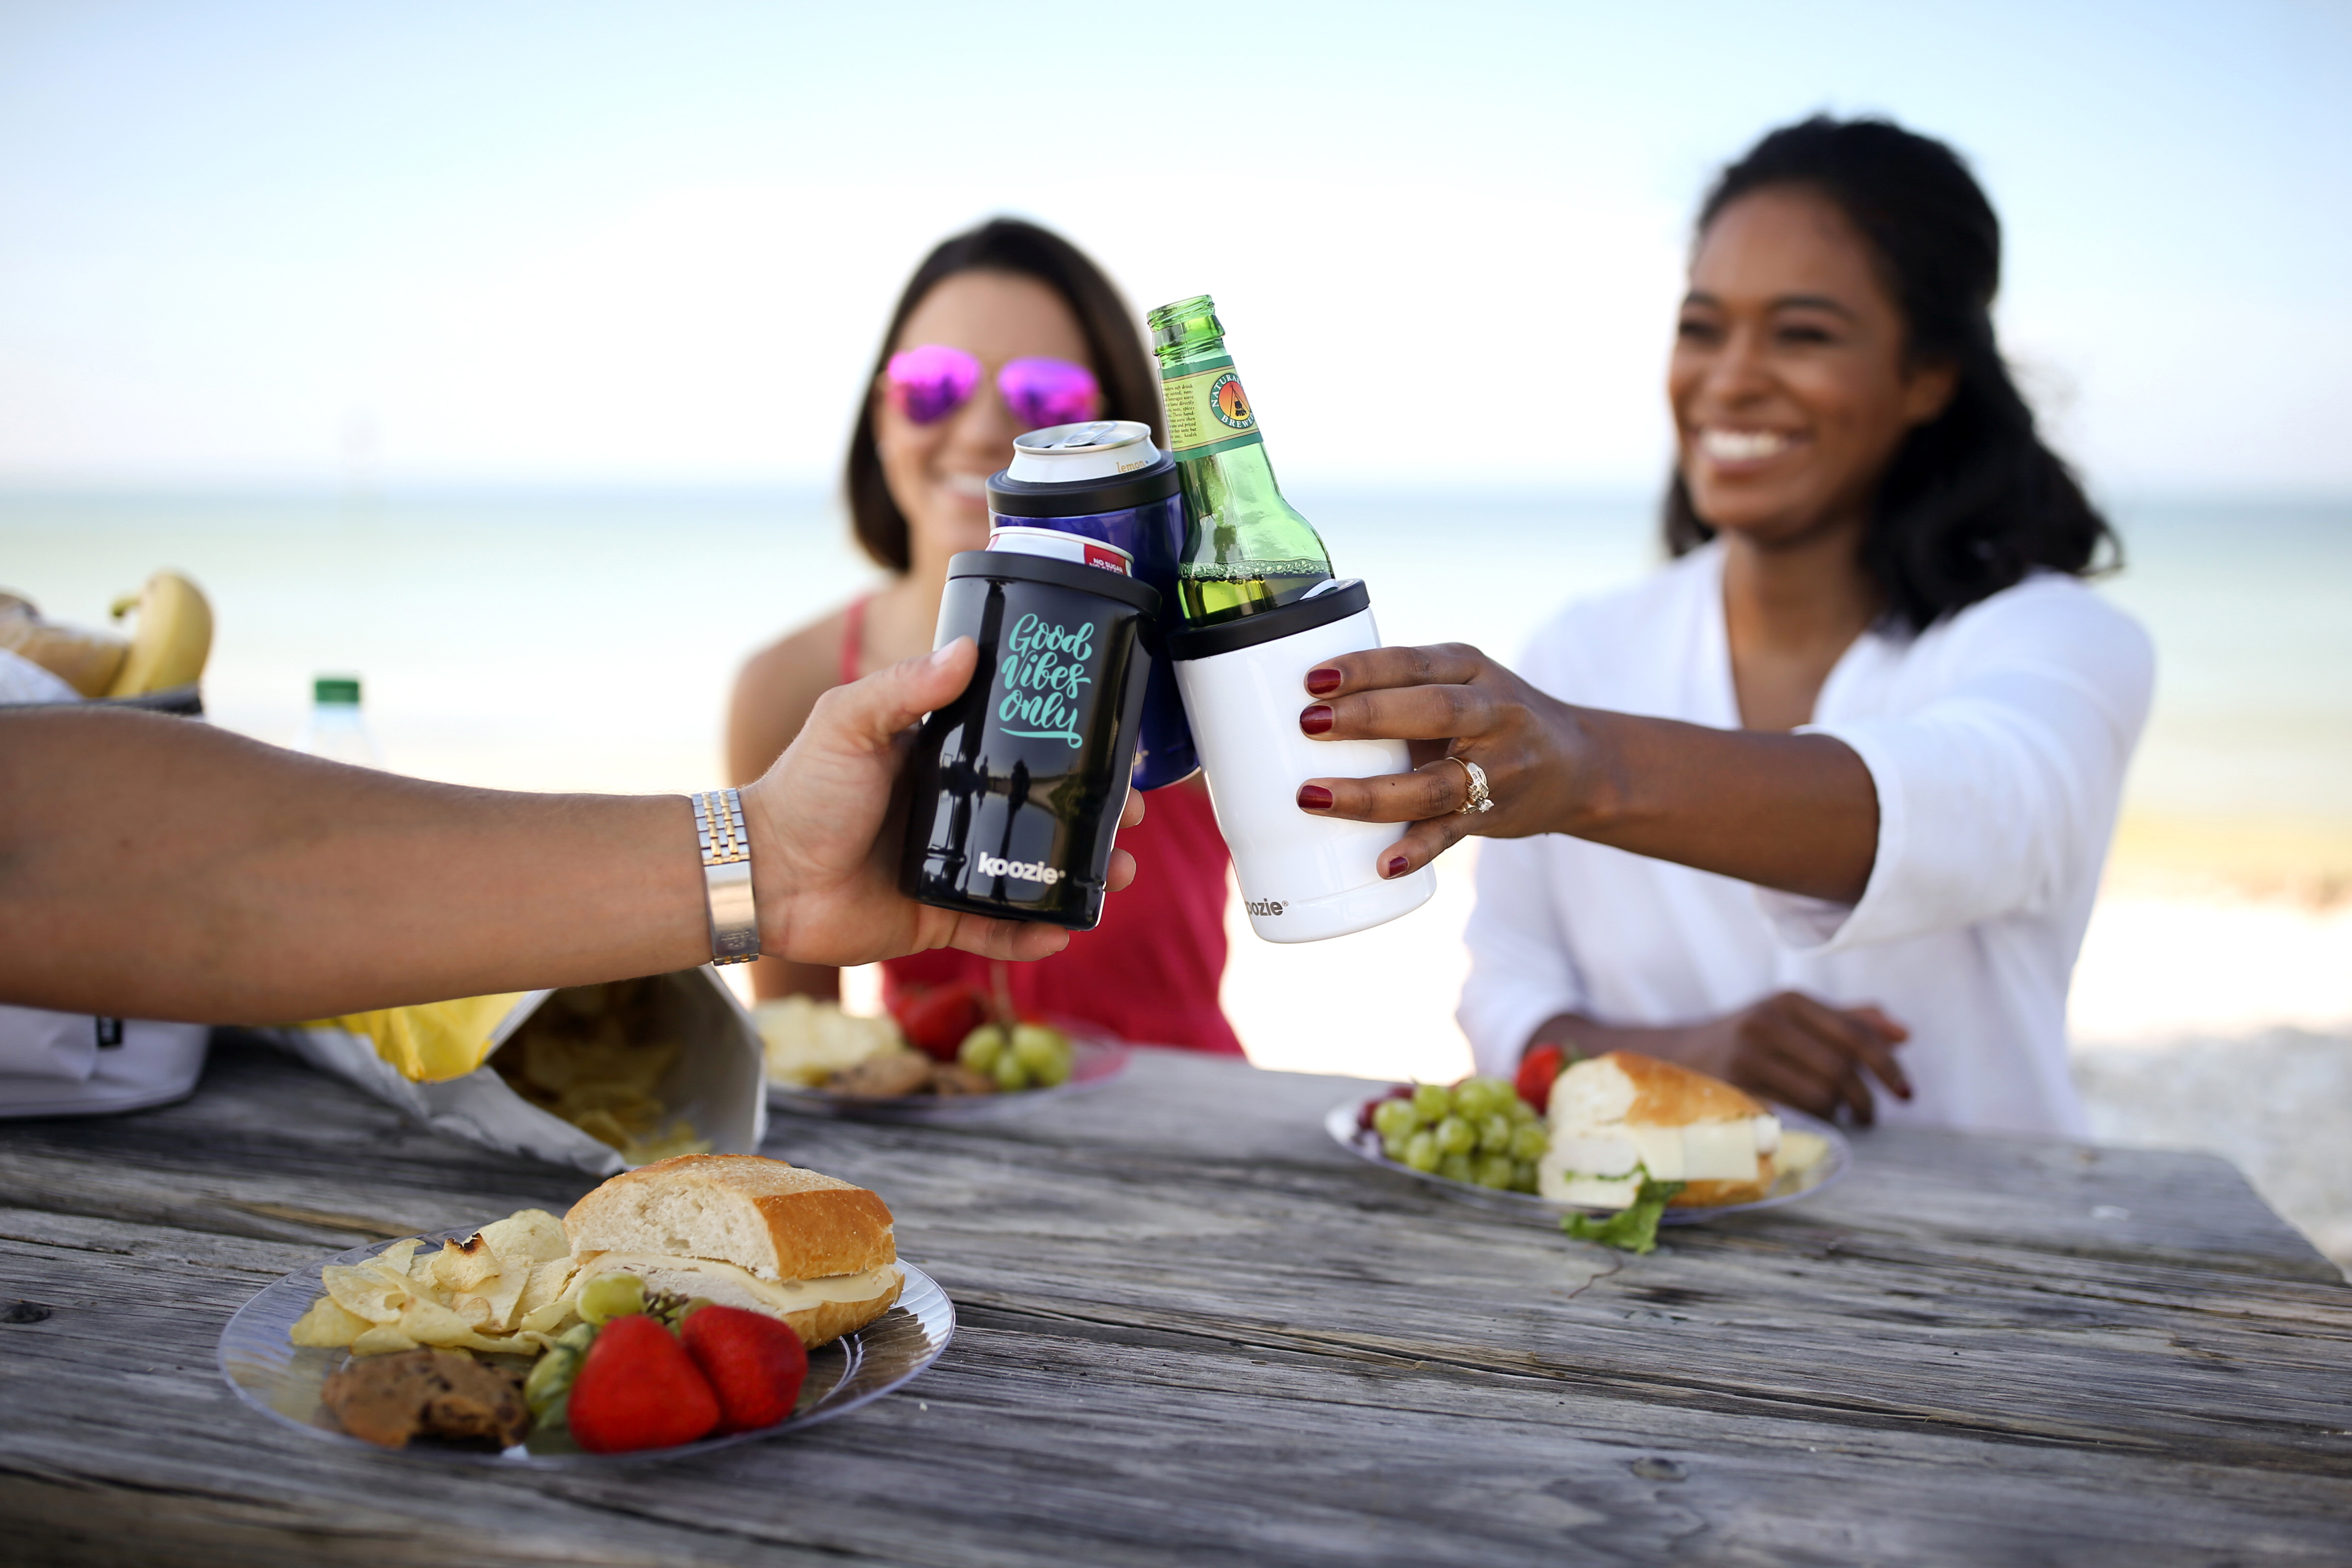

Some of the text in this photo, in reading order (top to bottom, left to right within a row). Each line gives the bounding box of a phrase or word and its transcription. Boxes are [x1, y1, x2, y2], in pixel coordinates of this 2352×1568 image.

[1211, 374, 1242, 408] NATURAL
[1116, 460, 1145, 473] lemon
[1093, 557, 1105, 566] NO
[1105, 561, 1123, 573] SUGAR
[1009, 614, 1094, 660] Good
[1001, 650, 1091, 699] Vibes
